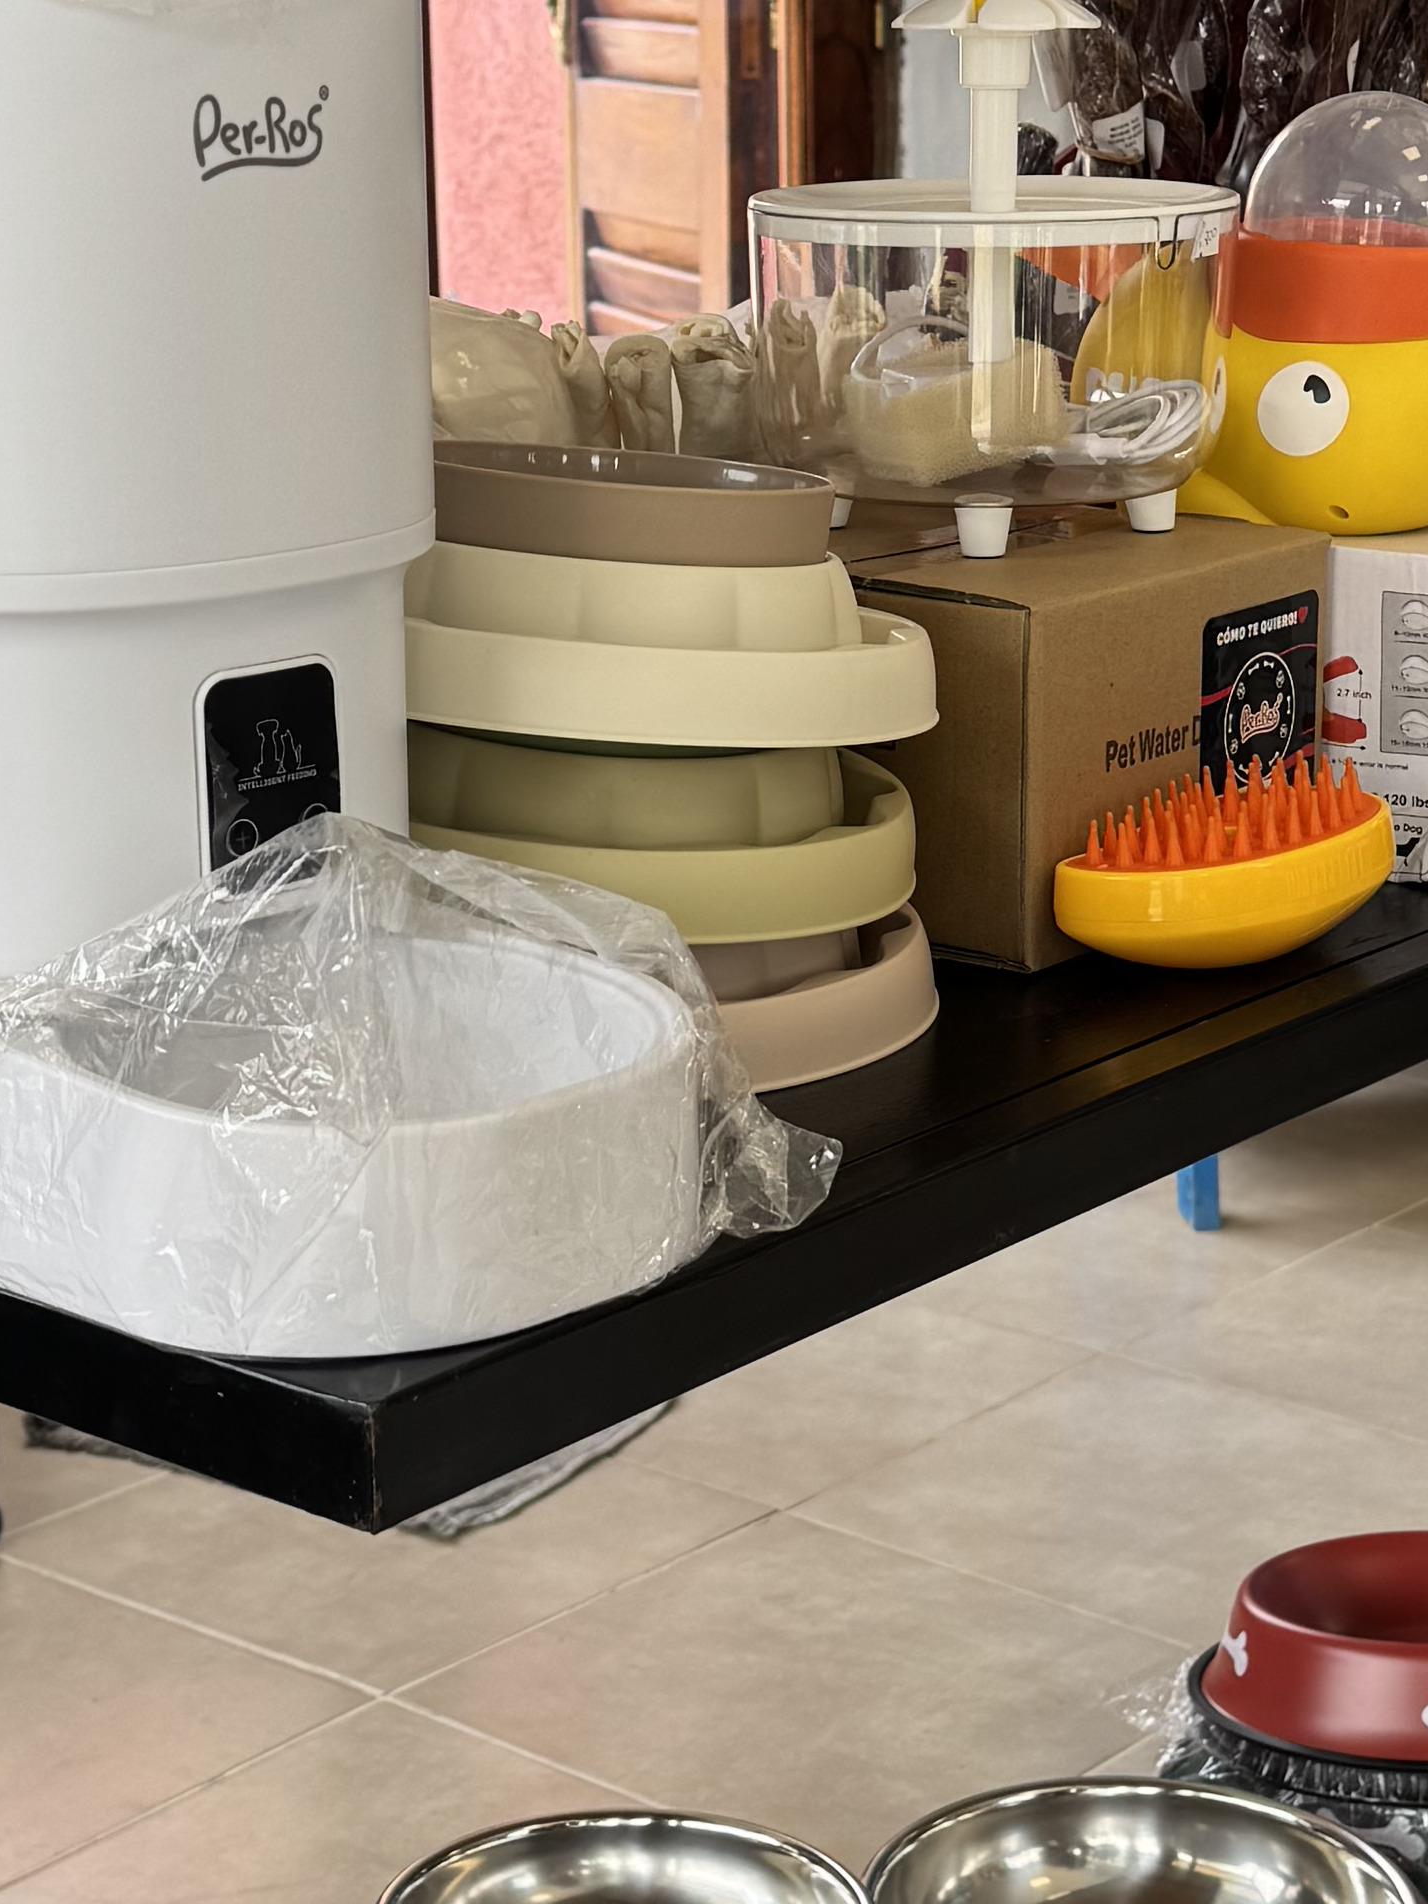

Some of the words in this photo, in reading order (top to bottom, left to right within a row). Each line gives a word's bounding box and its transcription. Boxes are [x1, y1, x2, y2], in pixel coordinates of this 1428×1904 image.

[1216, 625, 1246, 647] CÓMO
[1247, 621, 1259, 637] TE
[1260, 609, 1298, 636] QUIERO!
[1352, 689, 1373, 701] inch
[1105, 734, 1136, 773] Pet
[1138, 723, 1189, 764] Water
[1403, 822, 1423, 836] Dog
